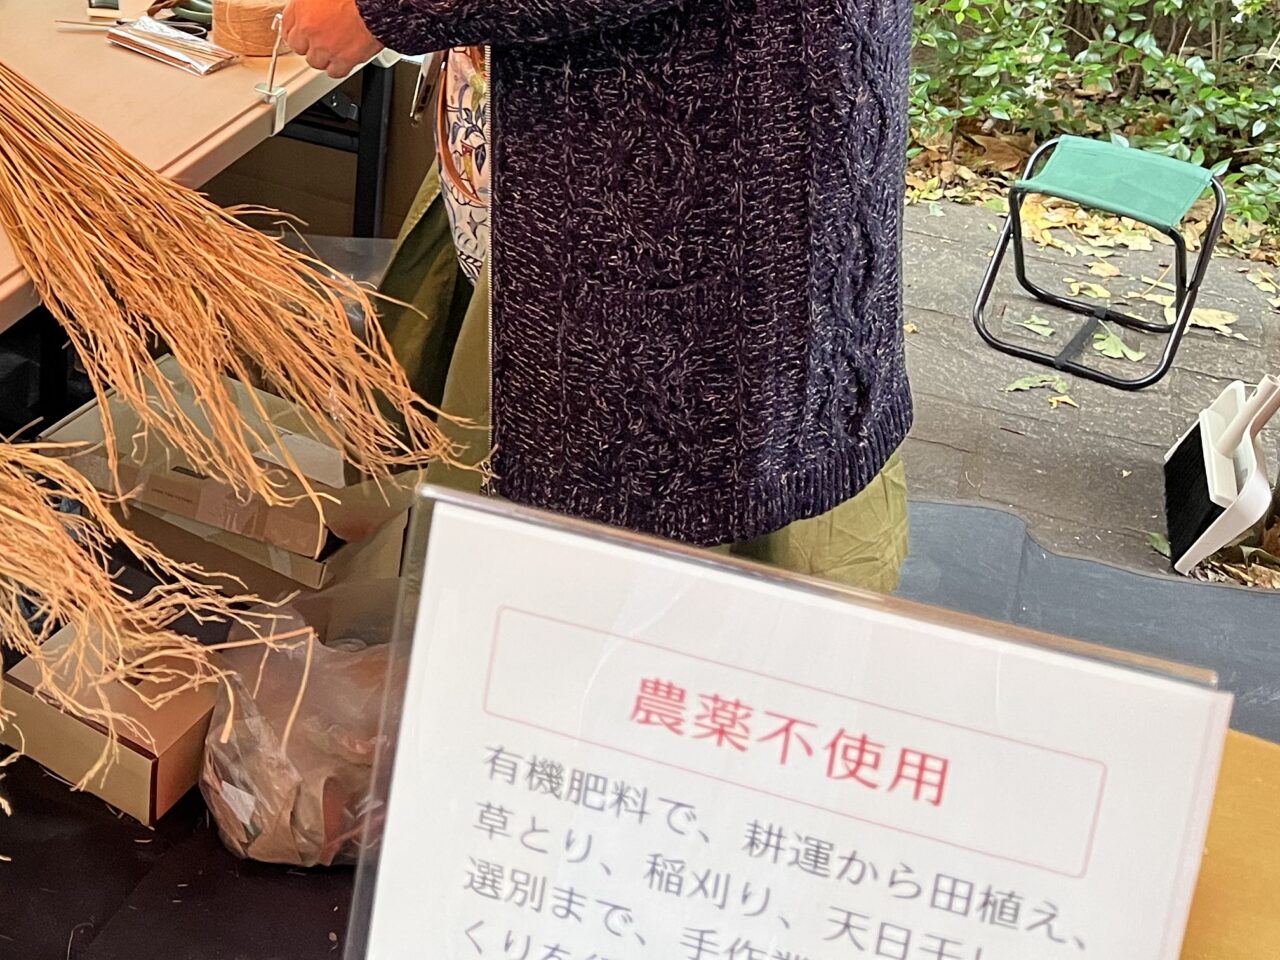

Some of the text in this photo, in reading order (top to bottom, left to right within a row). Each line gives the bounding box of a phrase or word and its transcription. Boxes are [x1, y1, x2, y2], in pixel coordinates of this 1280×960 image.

[629, 677, 949, 807] 農薬不使用
